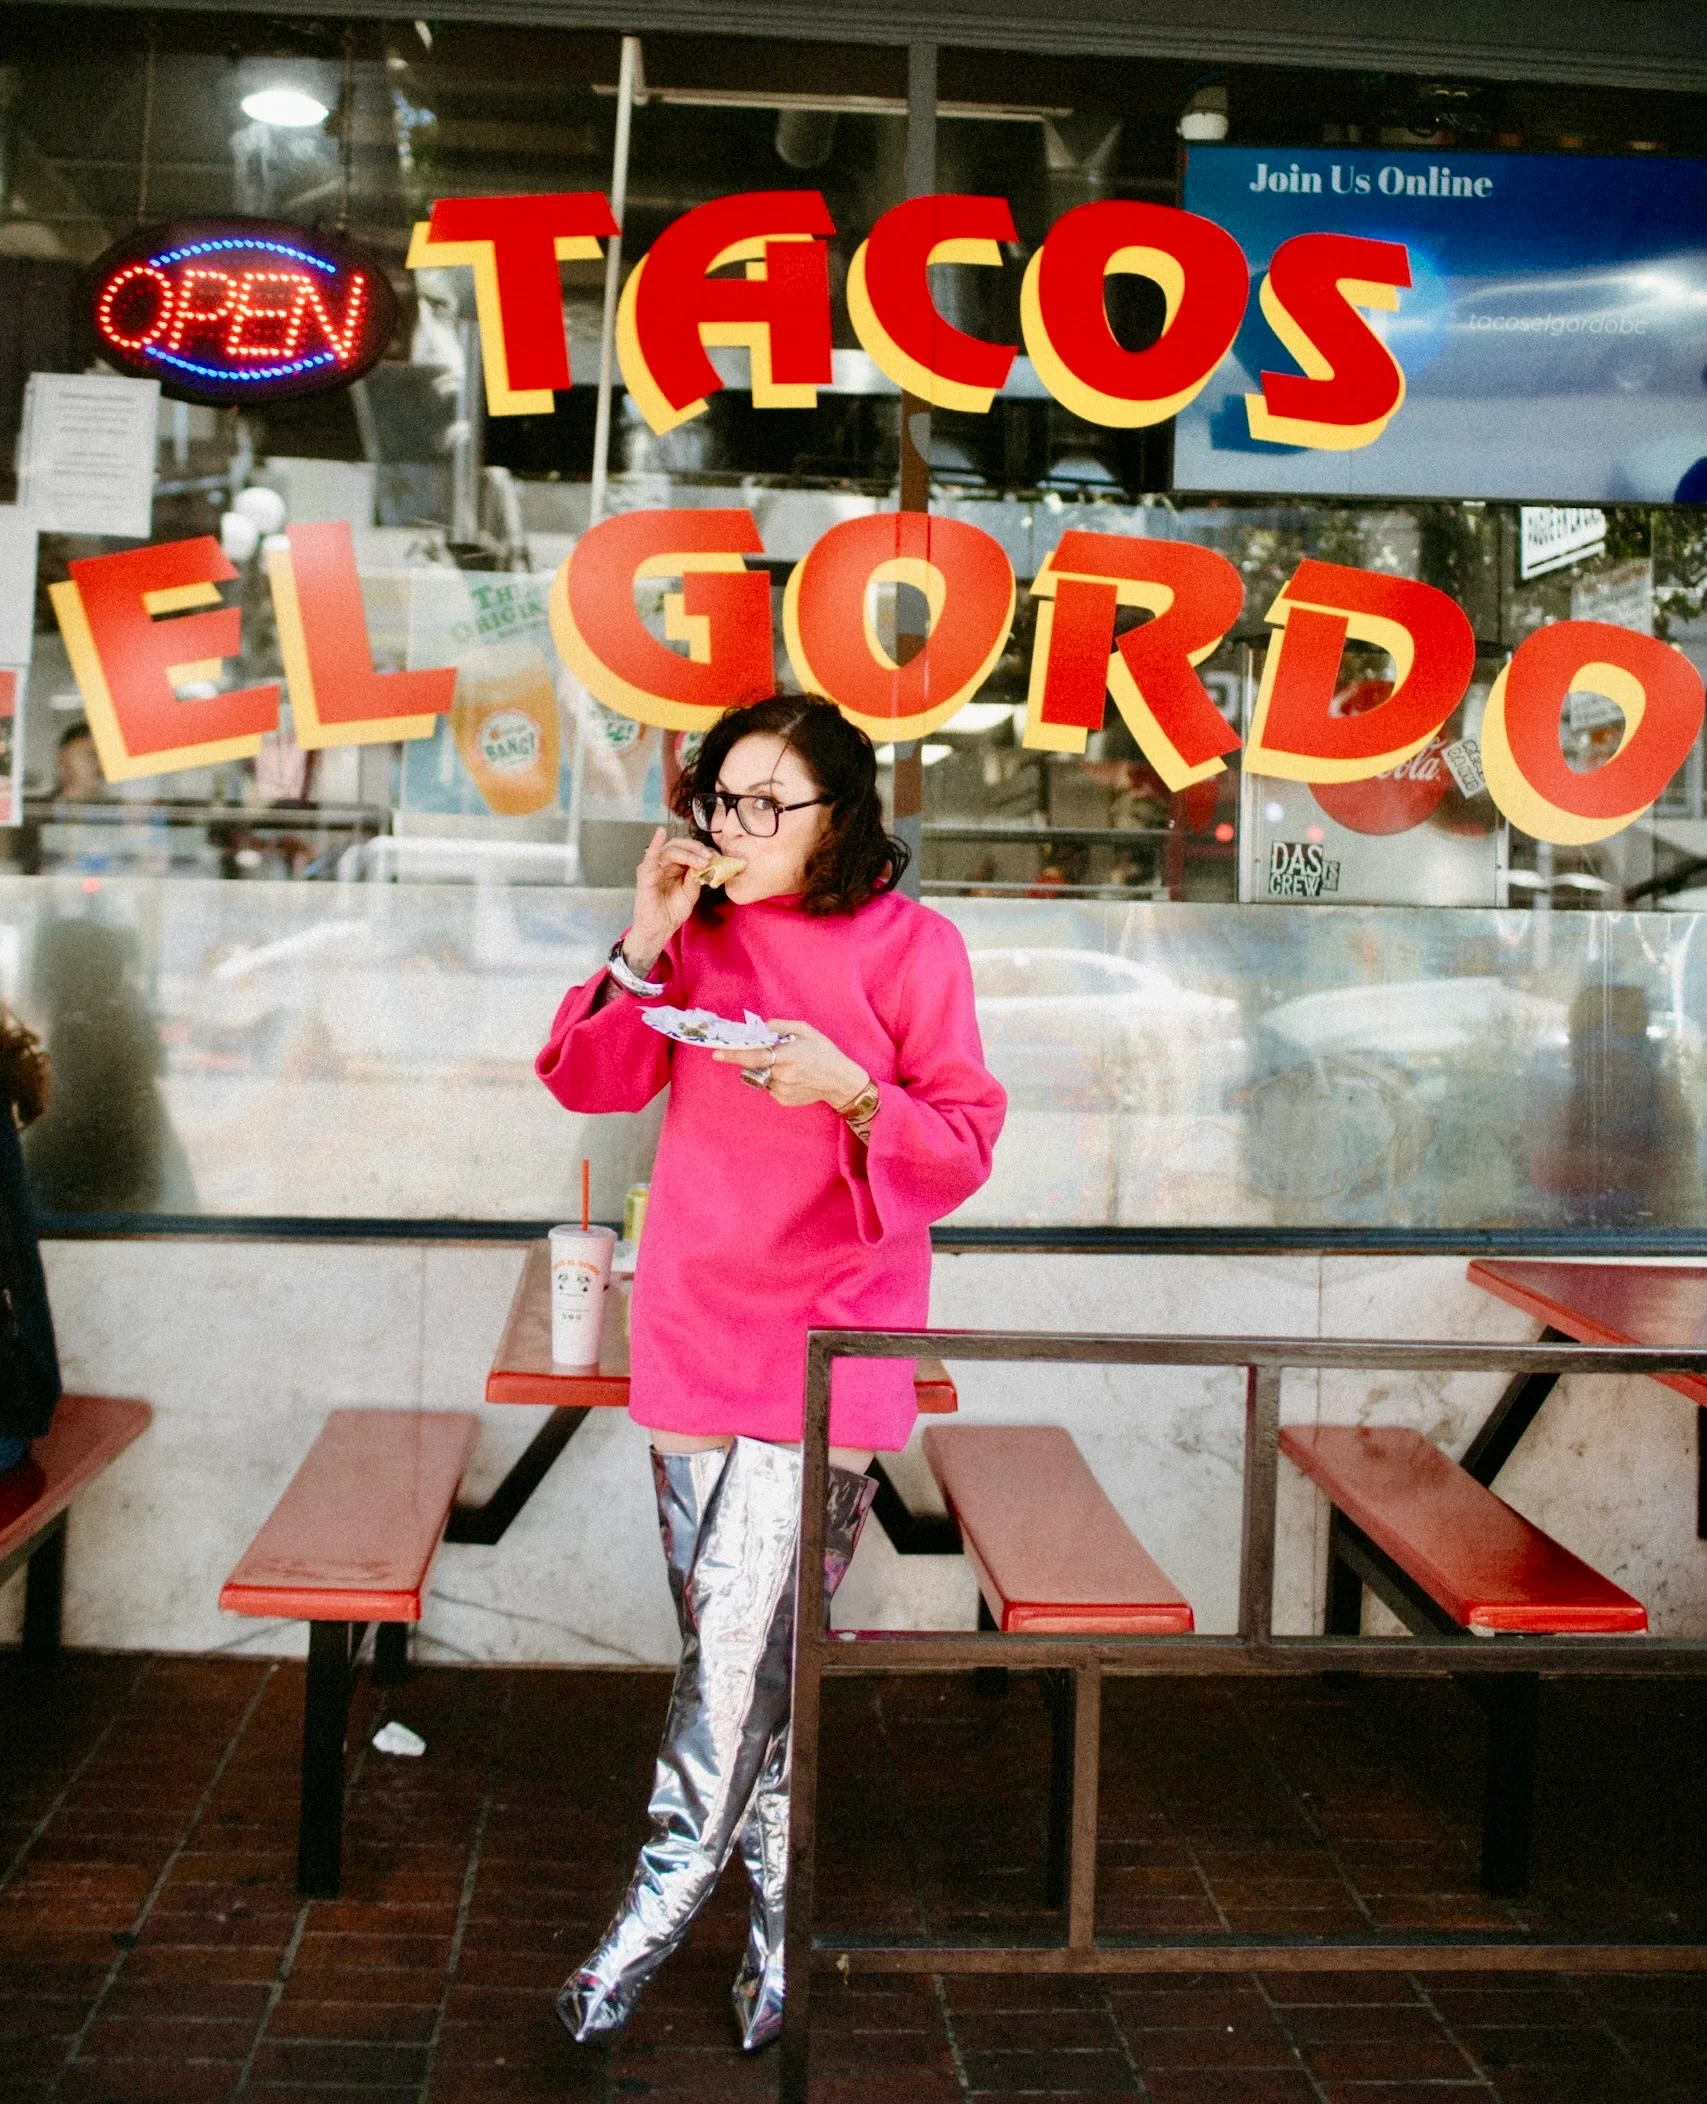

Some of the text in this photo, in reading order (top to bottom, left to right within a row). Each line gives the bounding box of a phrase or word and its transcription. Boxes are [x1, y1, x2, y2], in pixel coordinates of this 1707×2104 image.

[1249, 163, 1494, 199] Join Us Online
[98, 265, 366, 361] OPEN
[405, 190, 1412, 450] TACOS
[49, 507, 1706, 846] EL GORDO
[1269, 873, 1321, 897] CREW
[1271, 841, 1323, 878] DAS
